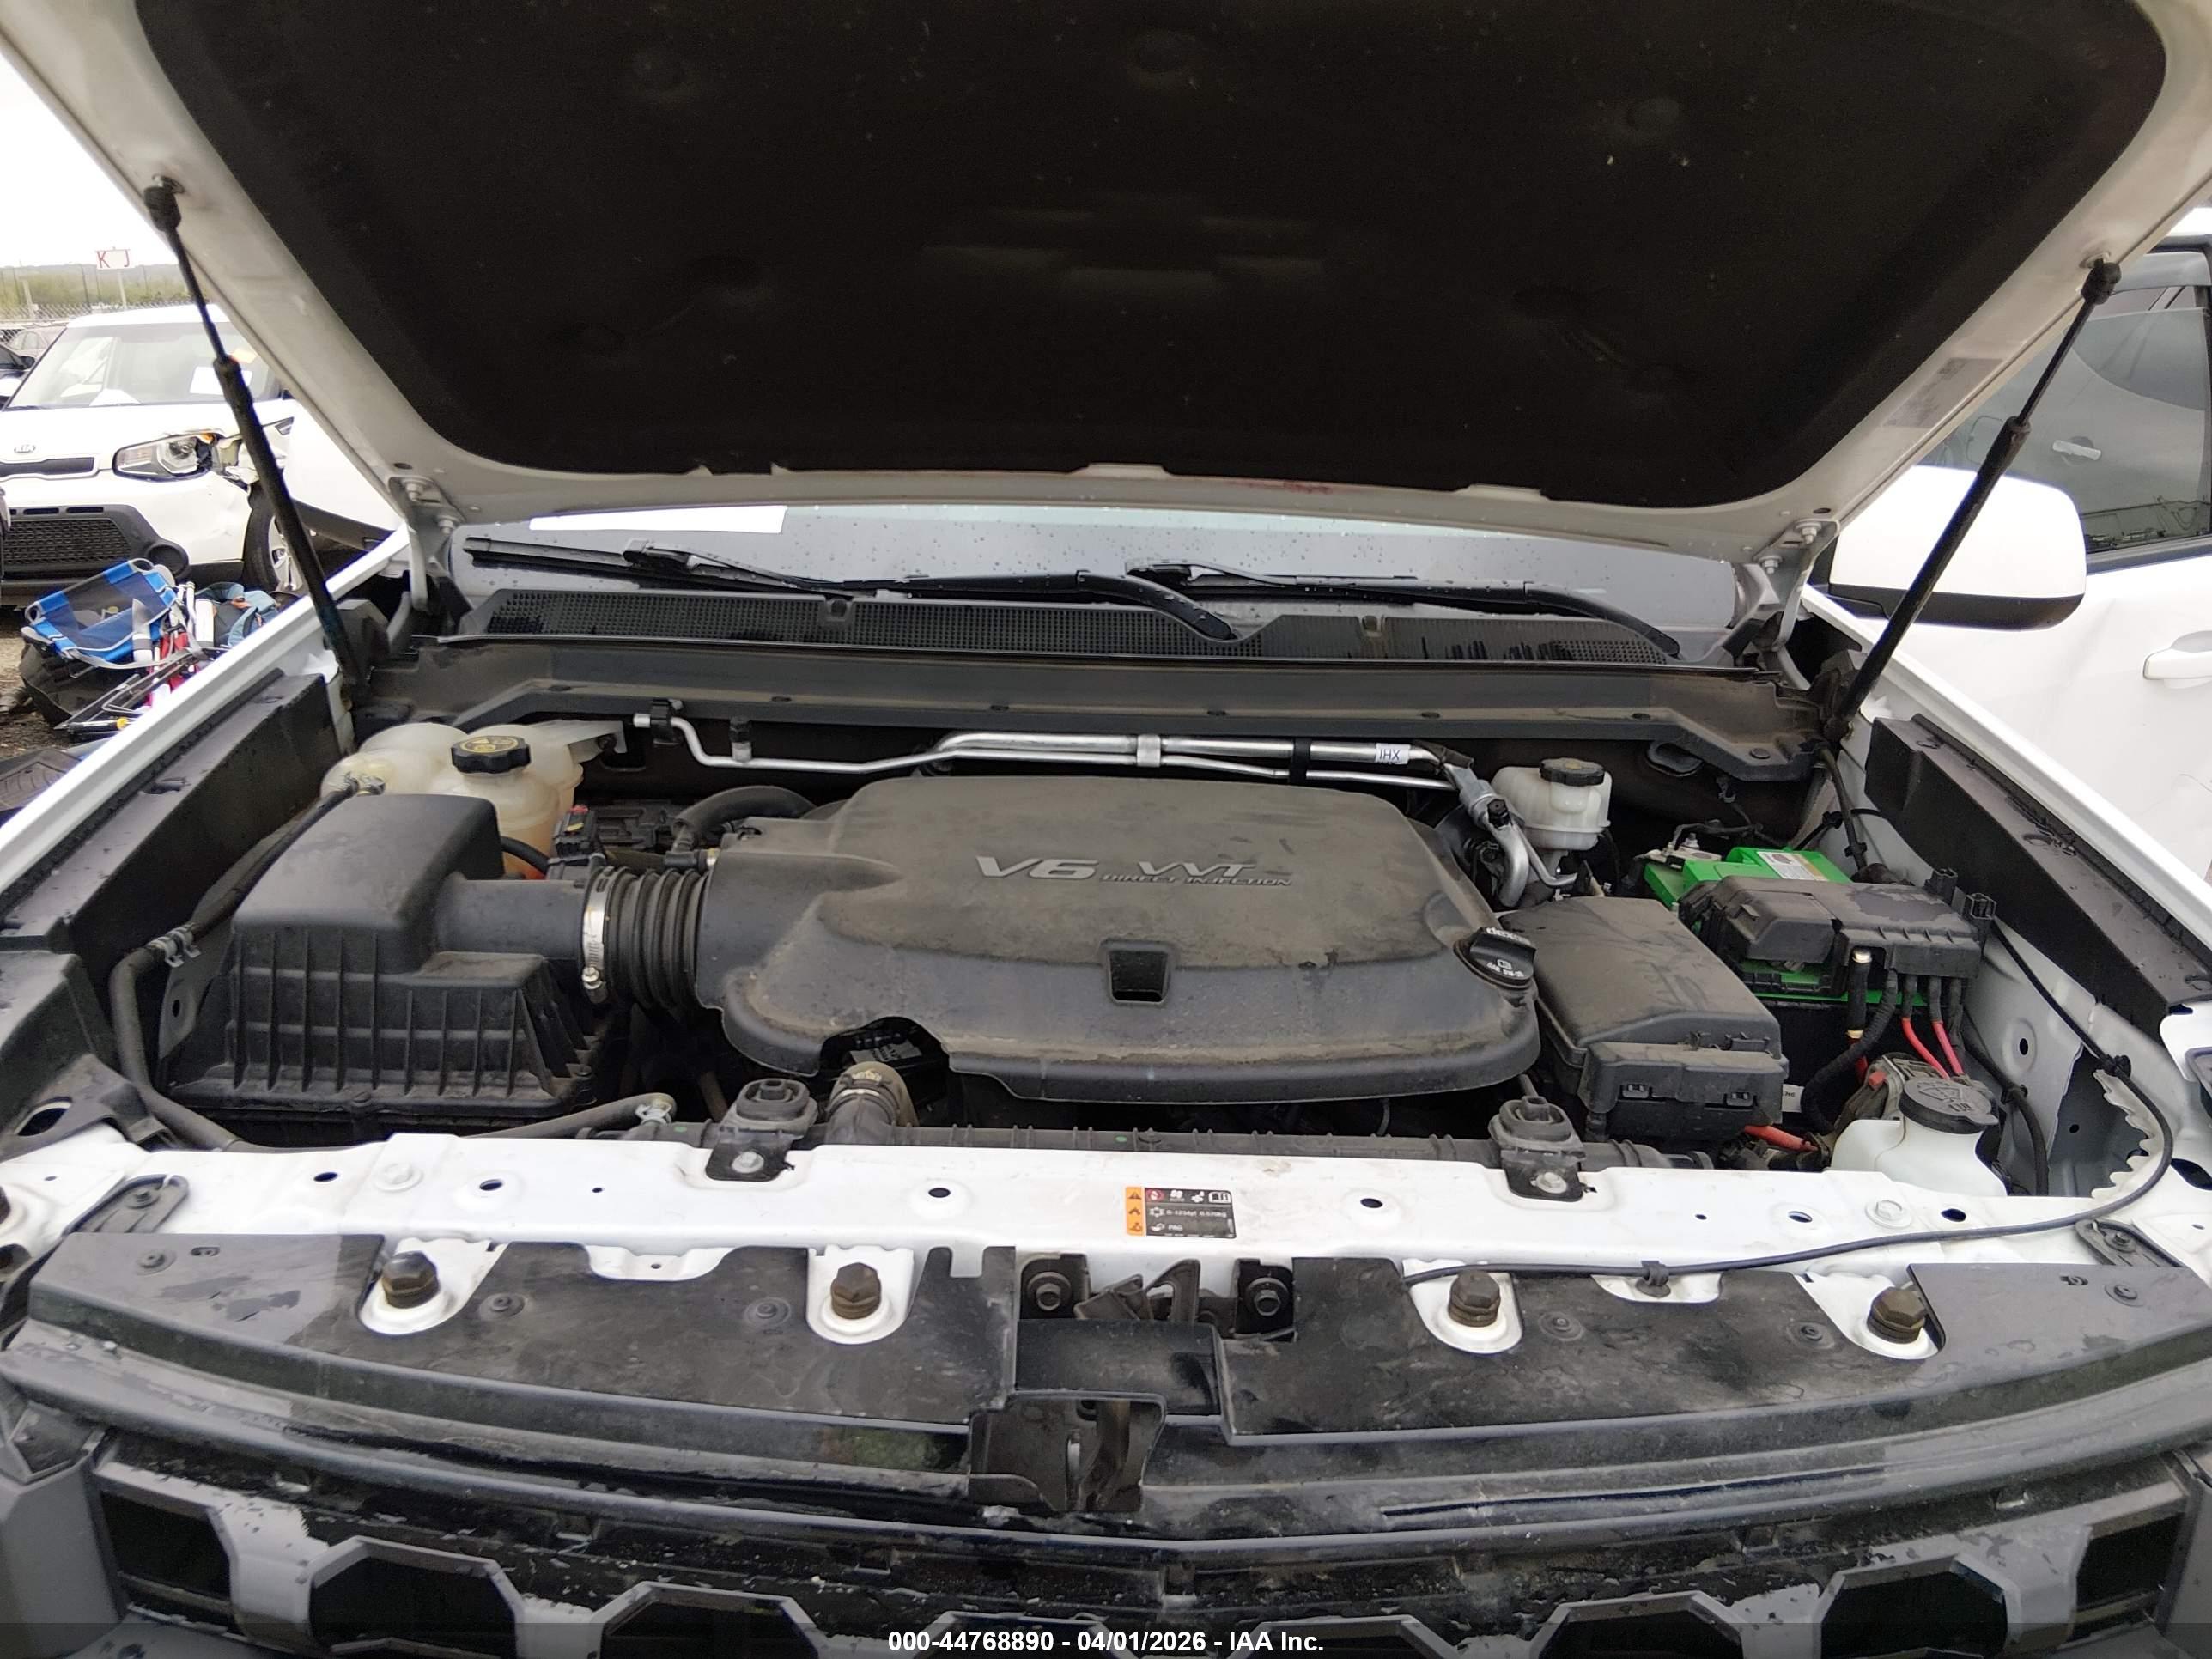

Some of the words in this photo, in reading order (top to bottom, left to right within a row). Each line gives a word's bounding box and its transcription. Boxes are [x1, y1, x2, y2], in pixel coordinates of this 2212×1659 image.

[97, 251, 110, 268] K
[124, 249, 130, 267] J
[975, 854, 1099, 880] V6
[1137, 860, 1257, 877] VVT
[1102, 873, 1176, 884] DIRECT
[1185, 877, 1292, 886] INJECTION
